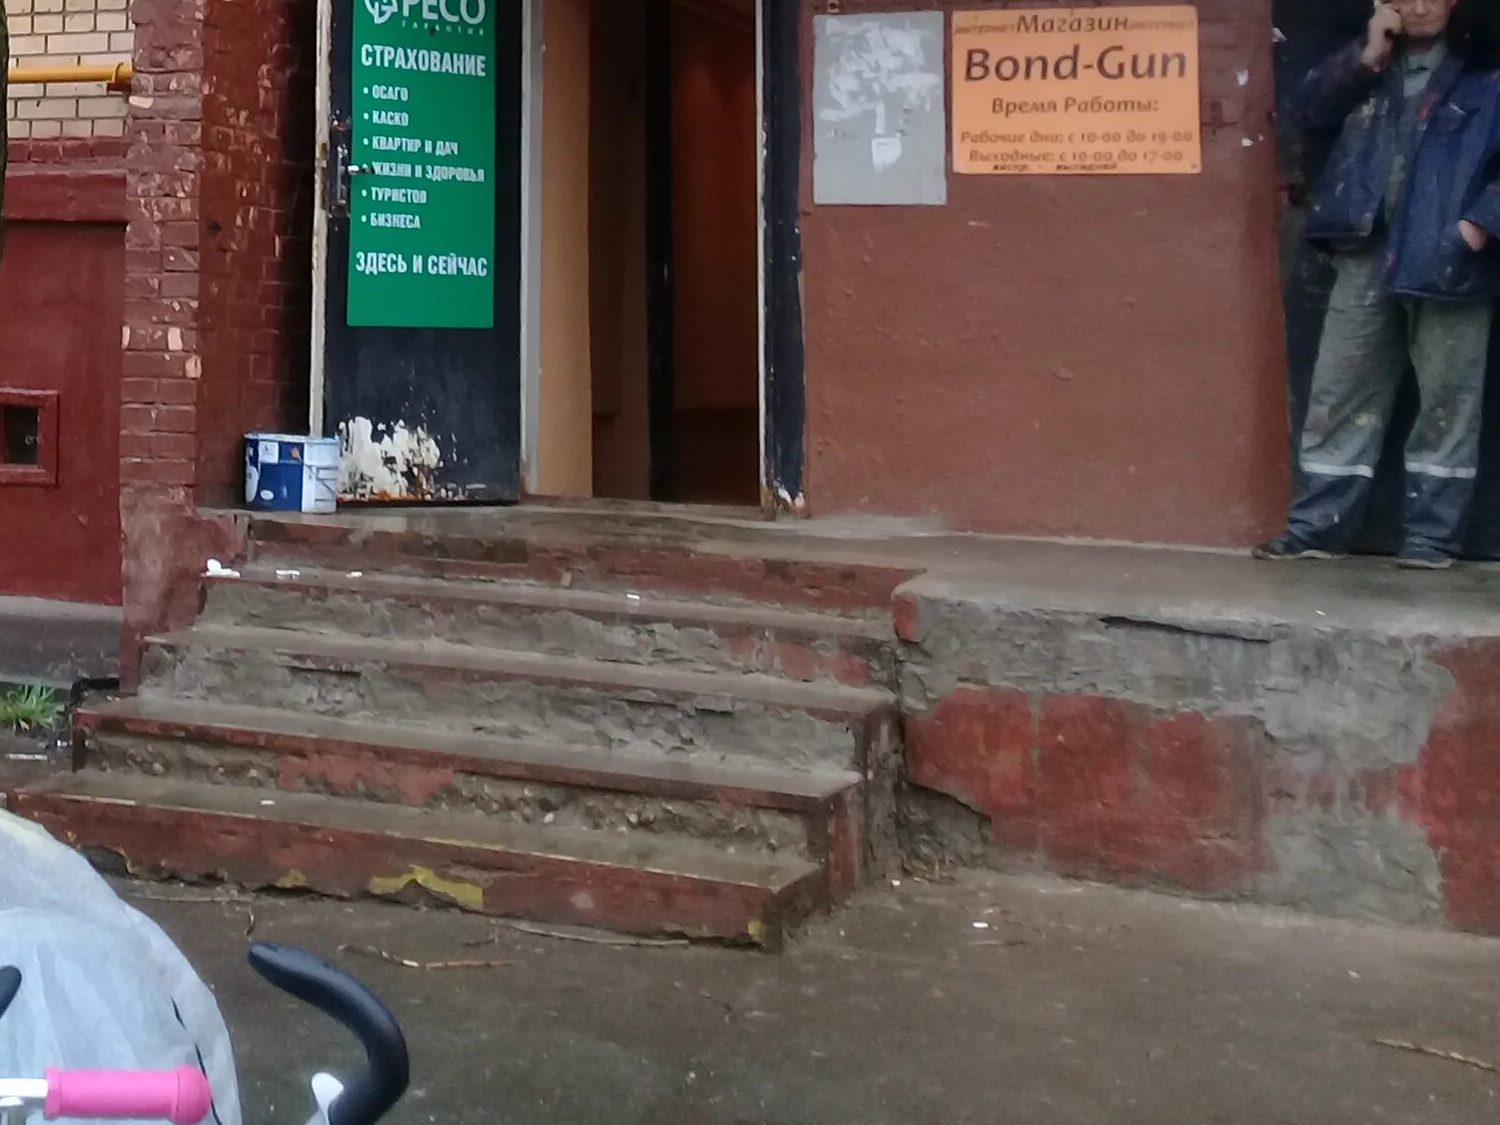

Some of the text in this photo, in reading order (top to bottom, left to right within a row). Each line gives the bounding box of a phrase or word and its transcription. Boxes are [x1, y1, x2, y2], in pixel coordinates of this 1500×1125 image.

[1016, 14, 1129, 34] Магазин
[361, 43, 487, 77] СТРАХОВАНИЕ
[964, 43, 1187, 82] Bond-Gun
[372, 84, 409, 102] ОСАГО
[991, 95, 1159, 118] Время Работы:
[372, 110, 409, 126] КАСКО
[372, 136, 422, 153] КВАРТИР
[435, 140, 459, 157] ДАЧ
[371, 161, 412, 178] ЖИЗНИ
[425, 164, 485, 183] ЗДОРОВЬЯ
[371, 186, 427, 204] ТУРИСТОВ
[370, 212, 421, 229] БИЗНЕСА
[355, 251, 488, 277] ЗДЕСЬ И СЕЙЧАС
